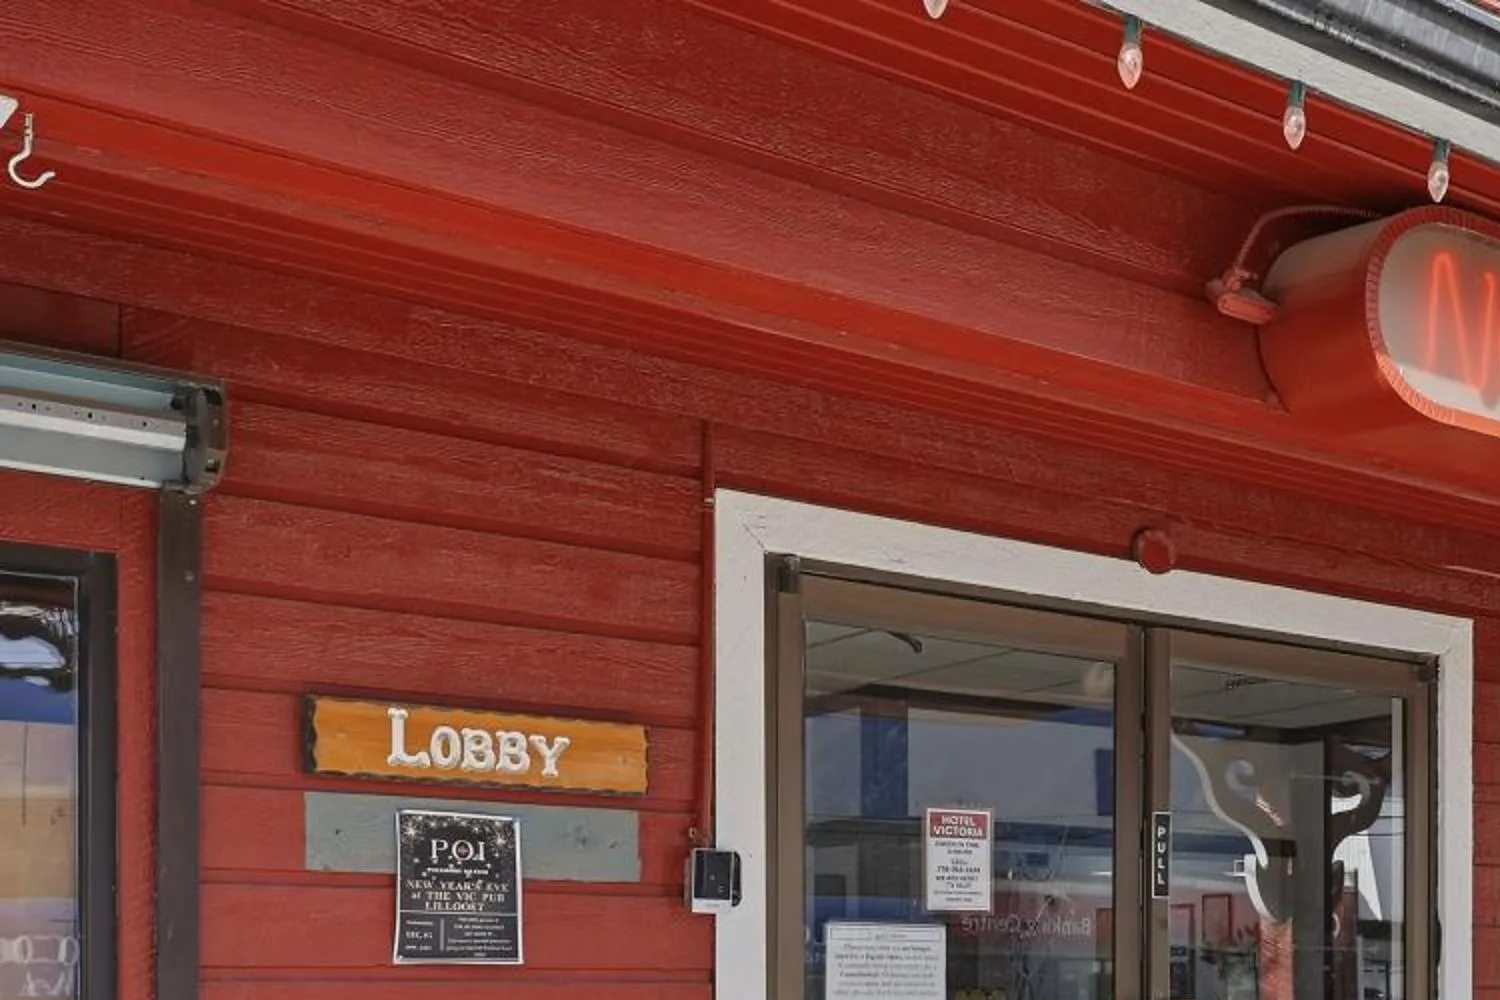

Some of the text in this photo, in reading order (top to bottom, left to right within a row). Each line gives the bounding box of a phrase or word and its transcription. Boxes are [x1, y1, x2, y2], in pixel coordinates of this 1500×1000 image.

[941, 815, 976, 826] HOTEL
[933, 825, 983, 836] VICTORIA
[1157, 825, 1167, 885] PULL
[406, 879, 509, 892] NEW YEAR'S EVE
[426, 892, 451, 901] THE
[456, 892, 477, 901] VIC
[482, 893, 505, 902] PUB
